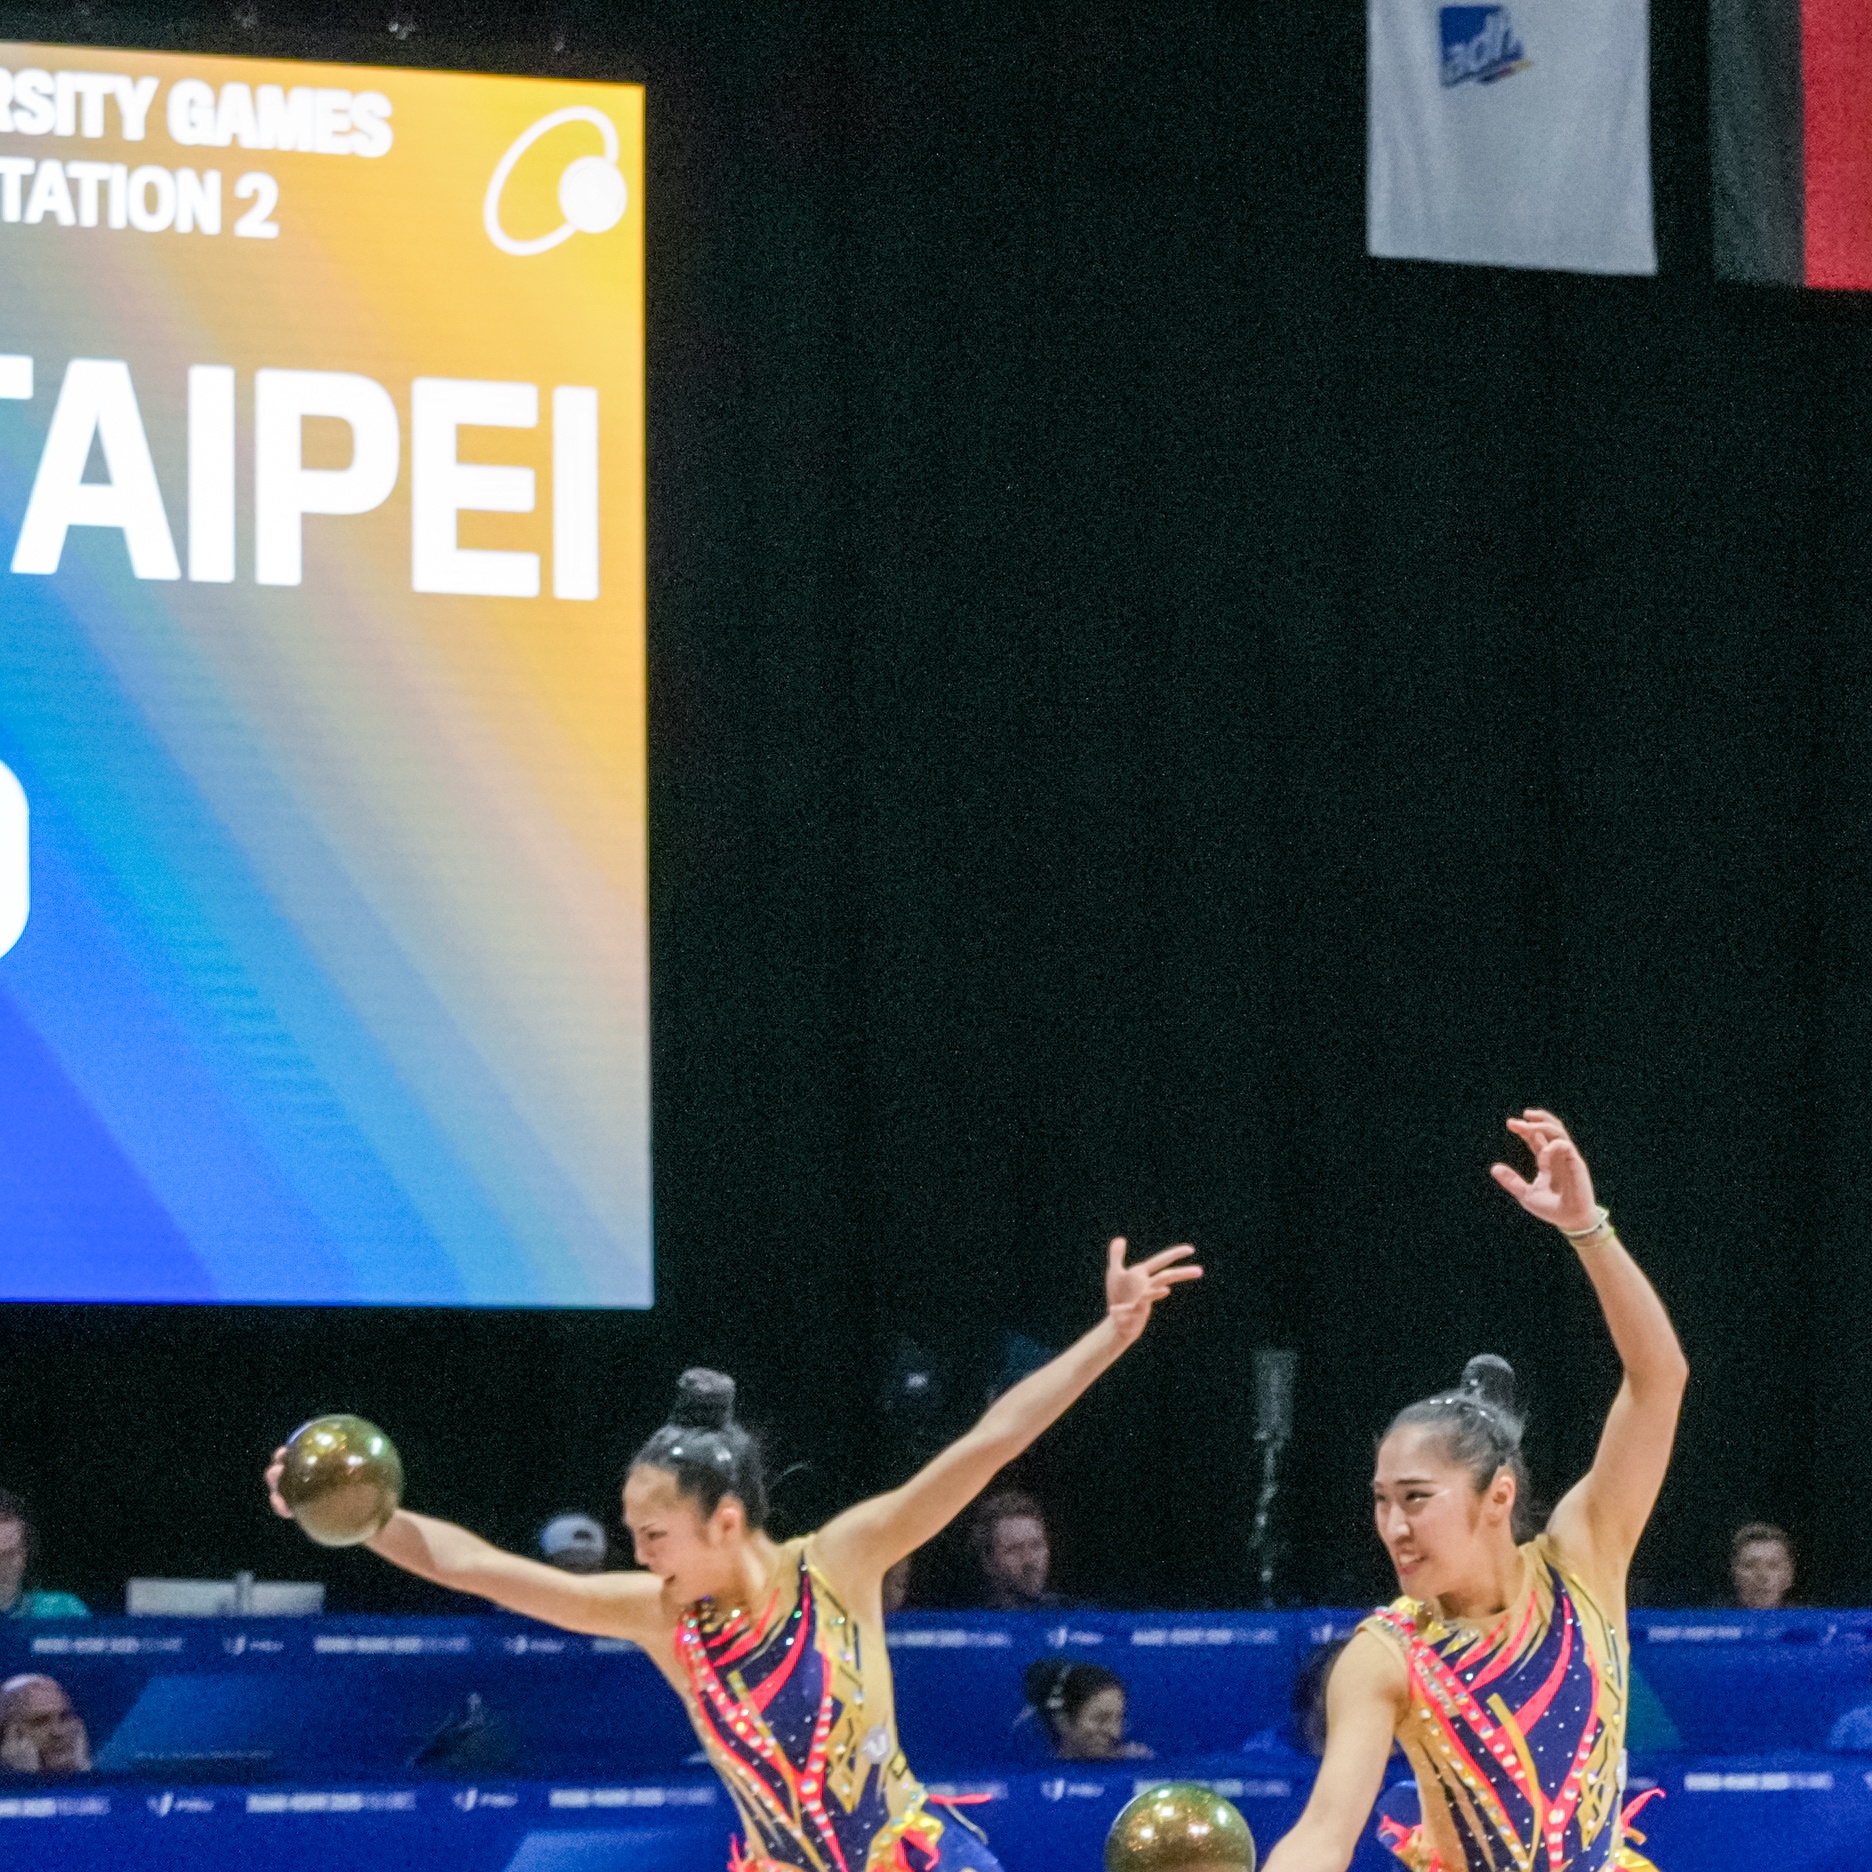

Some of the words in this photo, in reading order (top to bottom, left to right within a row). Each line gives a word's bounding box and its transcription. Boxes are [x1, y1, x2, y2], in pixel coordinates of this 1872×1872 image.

[166, 78, 394, 158] GAMES
[234, 171, 279, 239] 2
[0, 354, 600, 601] AIPEI
